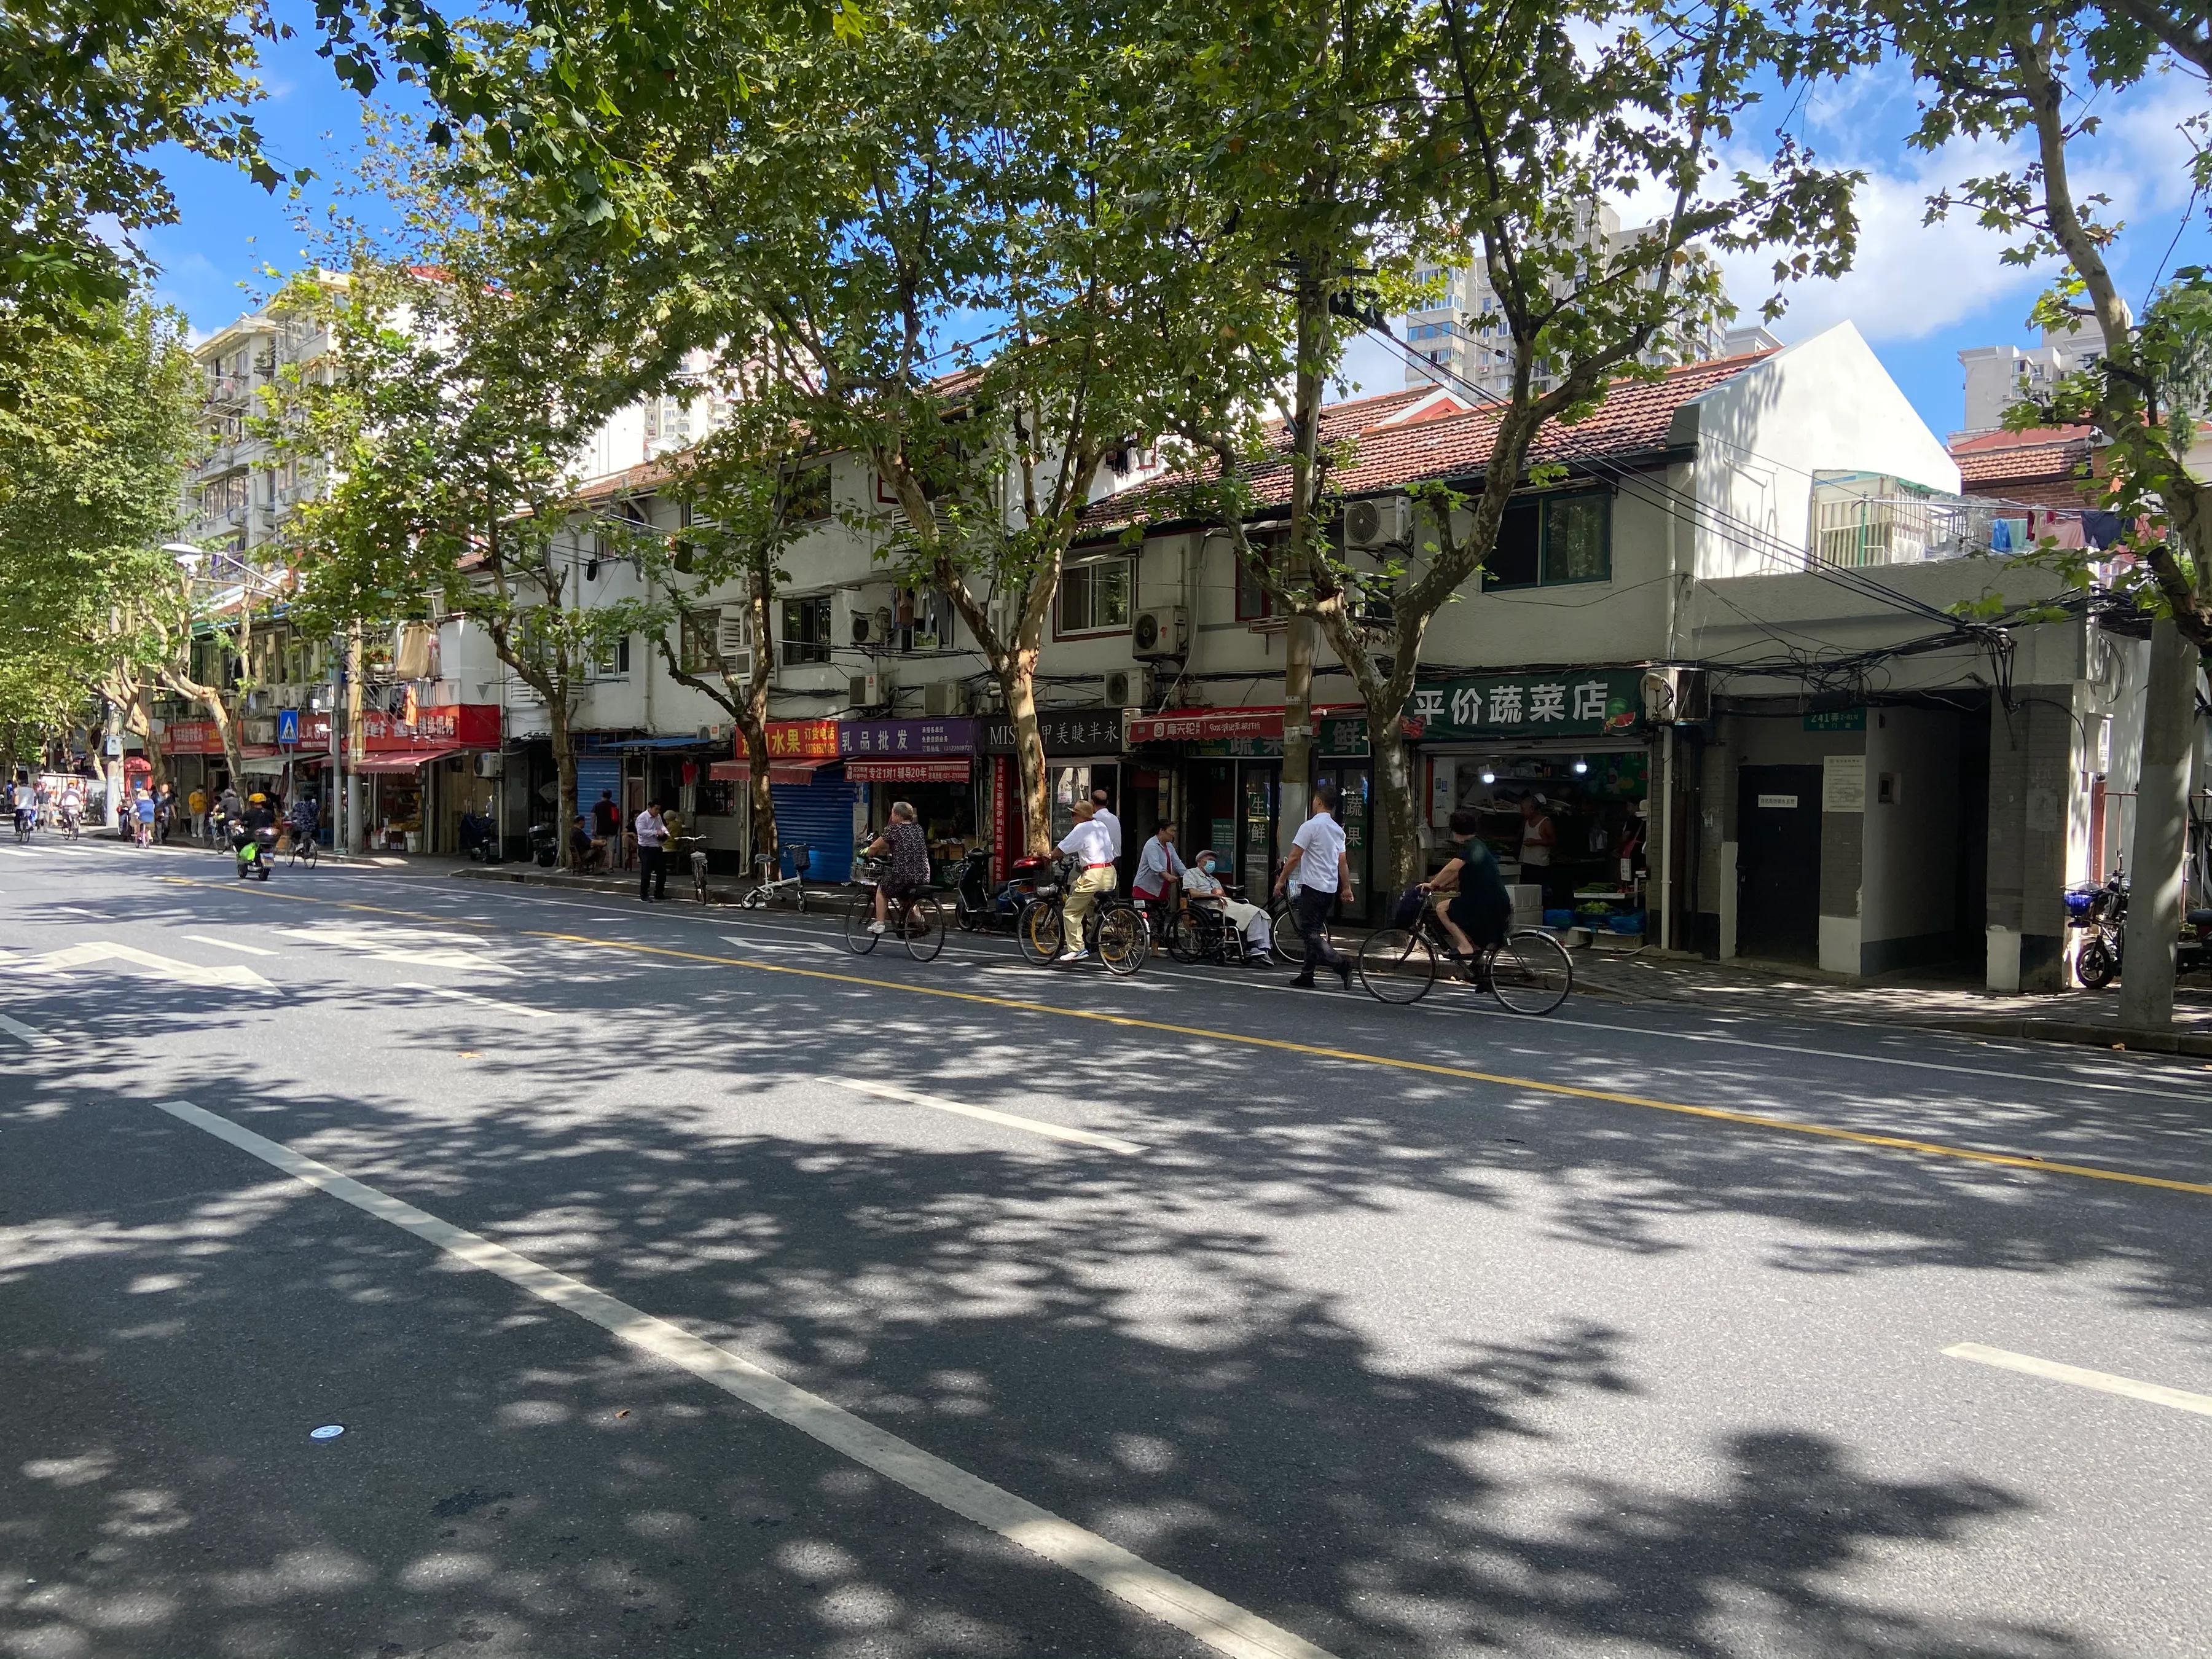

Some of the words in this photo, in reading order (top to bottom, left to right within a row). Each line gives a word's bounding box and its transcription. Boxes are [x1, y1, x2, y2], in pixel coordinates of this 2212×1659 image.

[1413, 680, 1608, 726] 平价蔬菜店
[804, 726, 835, 740] 订货电话
[842, 729, 908, 751] 乳品批发
